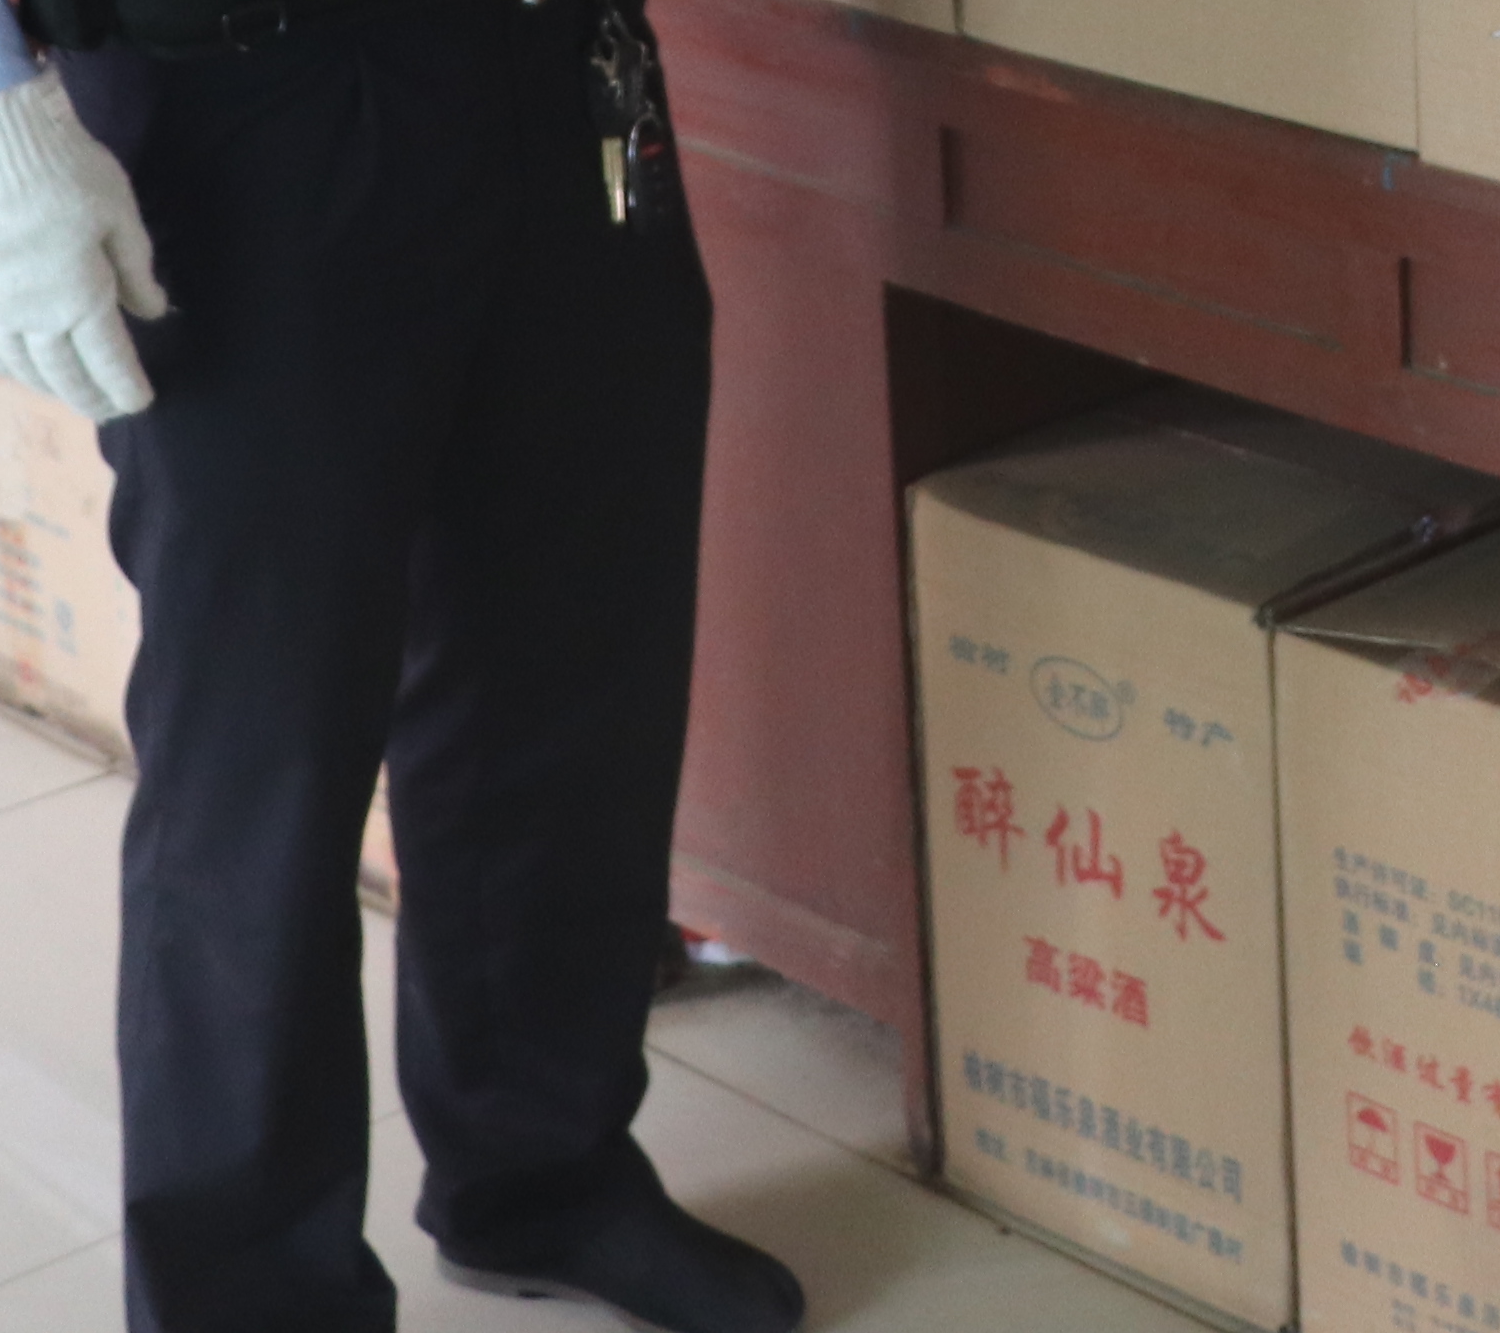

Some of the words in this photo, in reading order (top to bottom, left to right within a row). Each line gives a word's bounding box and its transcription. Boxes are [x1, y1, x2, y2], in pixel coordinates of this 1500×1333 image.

[952, 766, 1226, 943] 醉仙泉
[1023, 935, 1148, 1028] 高粱酒
